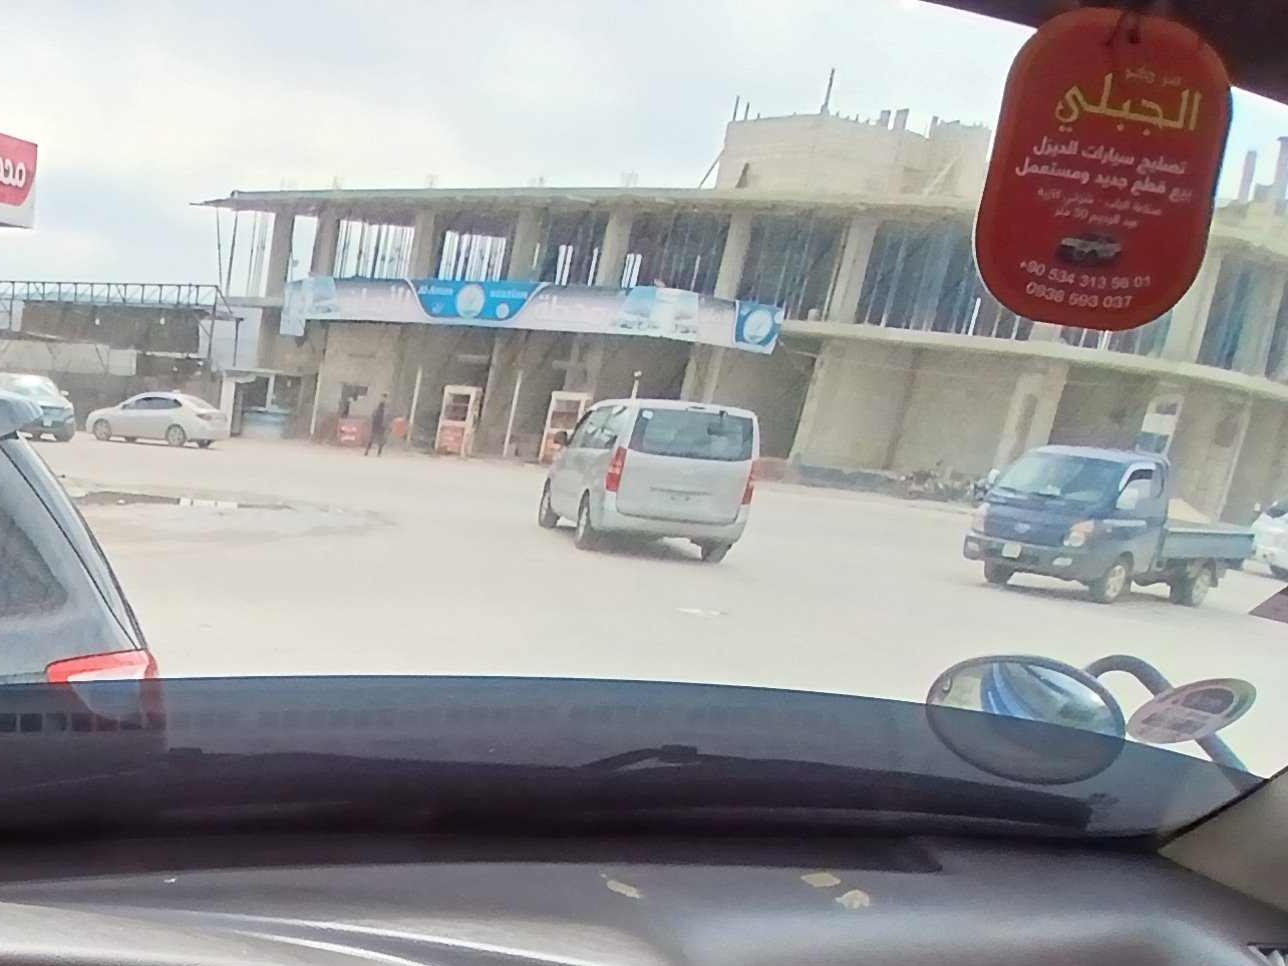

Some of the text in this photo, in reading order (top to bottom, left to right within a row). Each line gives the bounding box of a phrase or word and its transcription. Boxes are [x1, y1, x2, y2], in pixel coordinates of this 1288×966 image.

[1055, 73, 1203, 136] الجبلي
[1081, 145, 1136, 166] سيارات
[1015, 157, 1090, 185] ومستعمل
